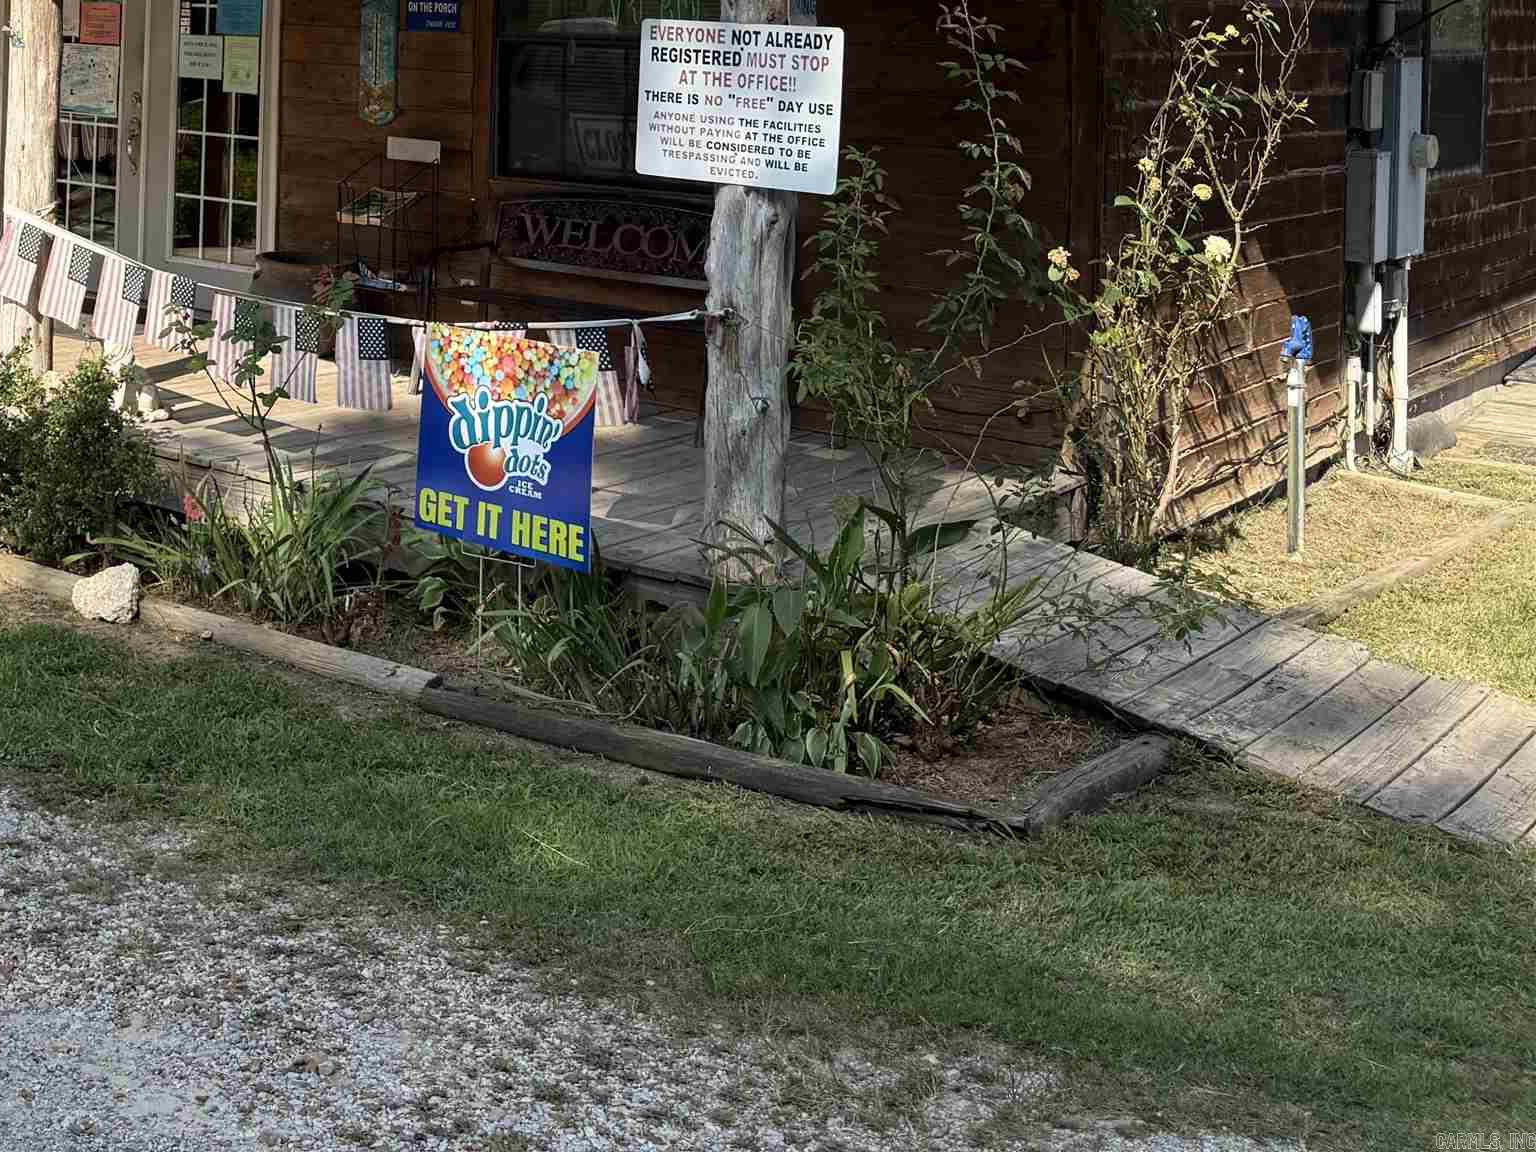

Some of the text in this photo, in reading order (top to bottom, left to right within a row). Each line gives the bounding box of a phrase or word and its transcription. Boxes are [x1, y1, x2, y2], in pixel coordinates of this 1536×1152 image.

[408, 1, 457, 15] ON THE PORCH
[650, 25, 833, 51] EVERYONE NOT ALREADY
[651, 46, 829, 72] REGISTERED MUST STOP
[679, 70, 796, 92] AT THE OFFICE!!
[644, 90, 833, 116] THERE IS NO "FREE" DAY USE
[653, 111, 821, 134] ANYONE USING THE FACILITIES
[648, 123, 825, 148] WITHOUT PAYING AT THE OFFICE
[660, 136, 812, 160] WILL BE CONSIDERED TO BE
[662, 149, 809, 172] TRESPASSING AND WILL BE
[710, 167, 759, 180] EVICTED.
[520, 212, 706, 264] WELCOM
[505, 447, 548, 482] dots
[508, 485, 542, 499] CREAM
[517, 480, 534, 490] ICE
[419, 487, 585, 562] GET IT HERE
